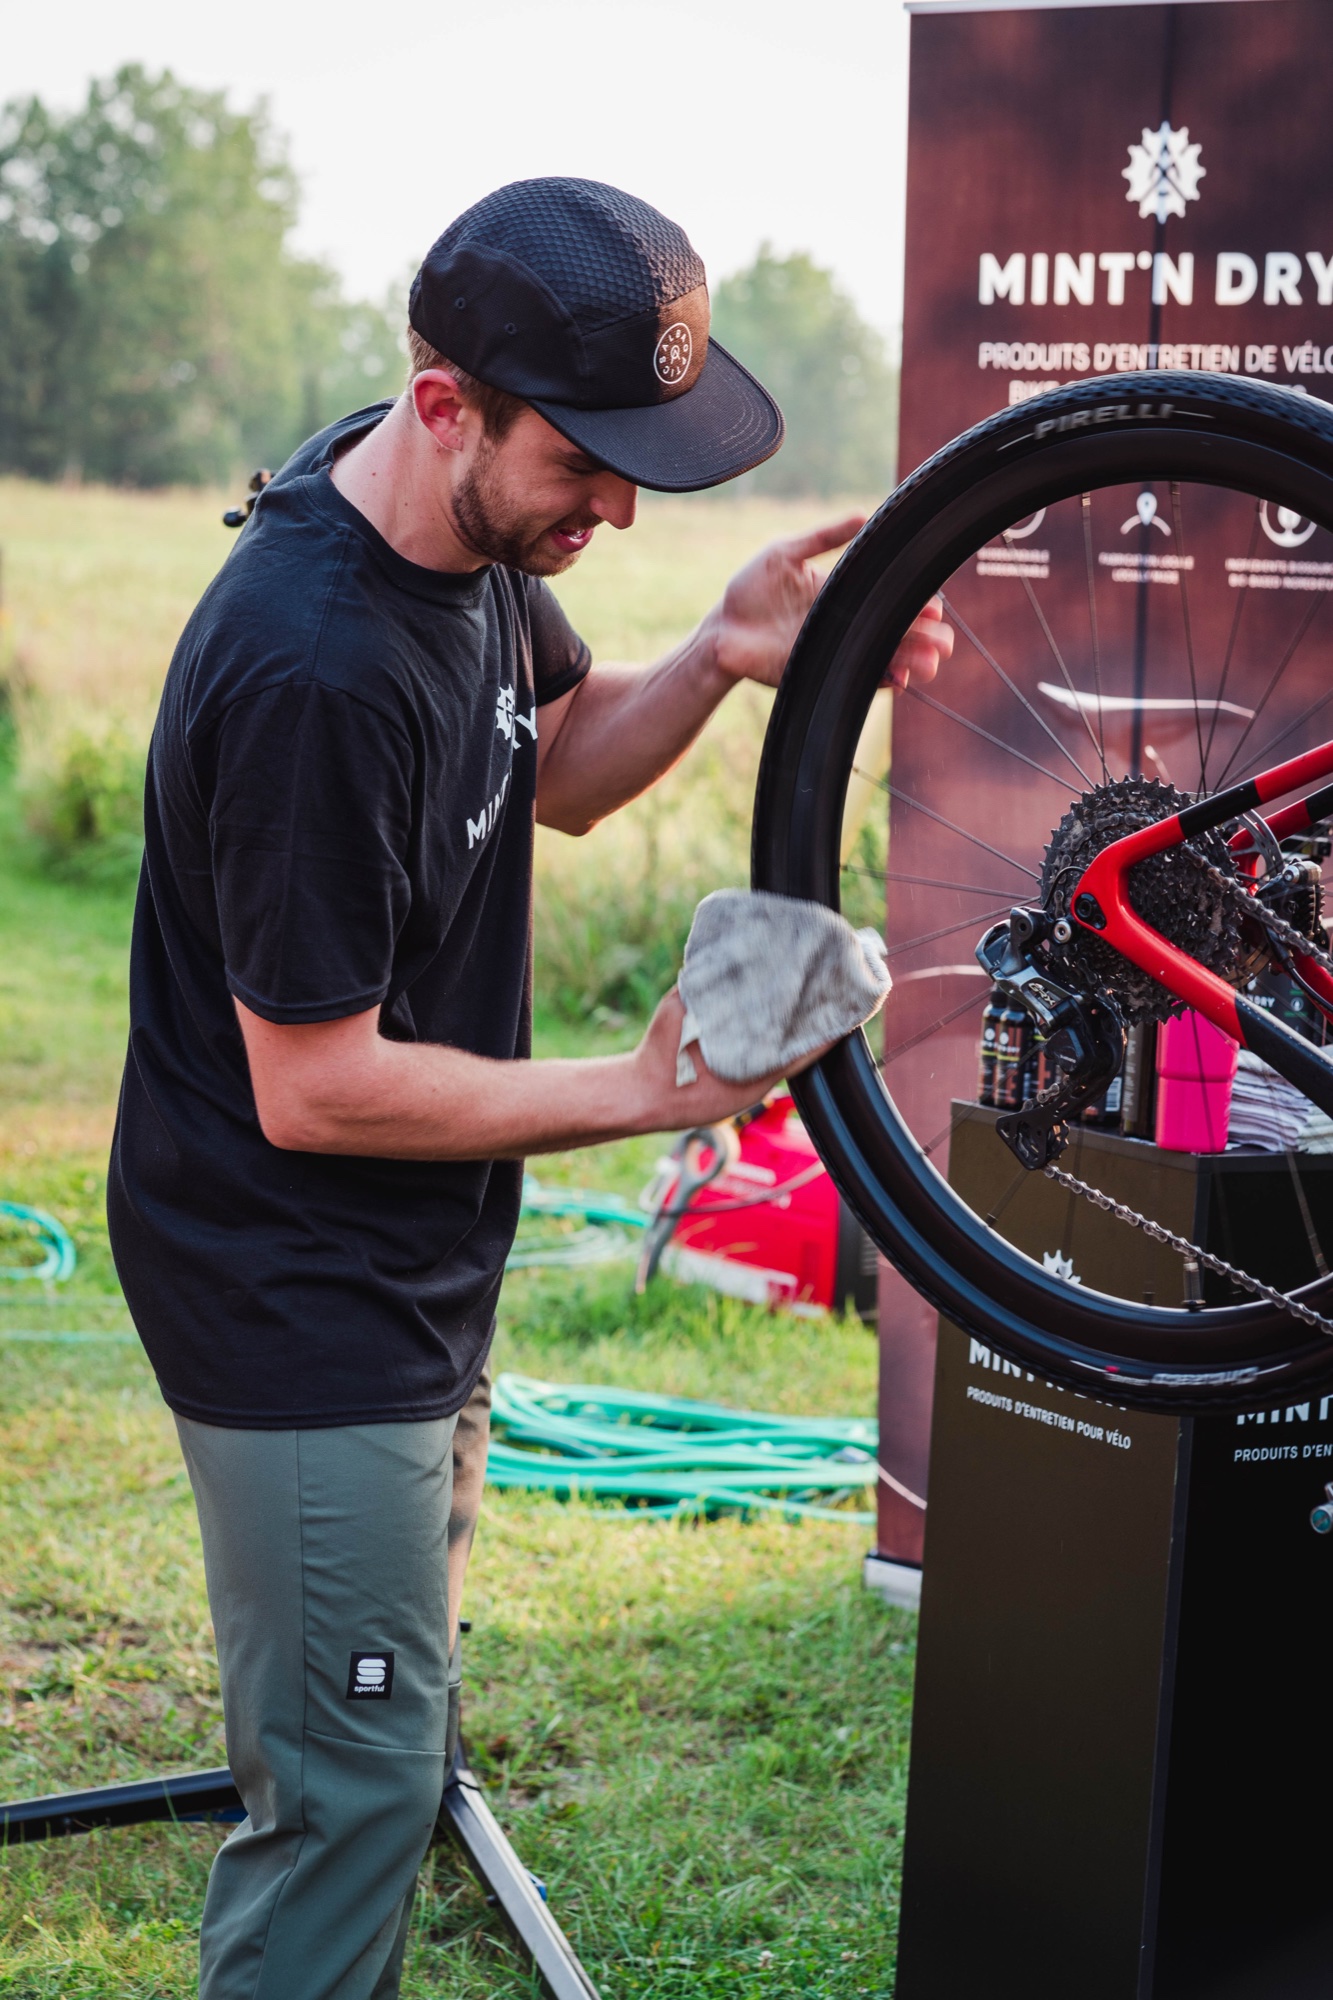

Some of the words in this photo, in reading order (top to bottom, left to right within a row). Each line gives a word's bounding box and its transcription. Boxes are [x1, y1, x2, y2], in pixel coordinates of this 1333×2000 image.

[978, 251, 1194, 305] MINT'N
[1215, 252, 1333, 305] DRY
[978, 342, 1091, 371] PRODUITS
[1093, 343, 1240, 373] D'ENTRETIEN
[1245, 345, 1278, 373] DE
[1033, 403, 1175, 440] PIRELLI
[967, 1386, 1013, 1412] PRODUITS
[1014, 1401, 1075, 1432] D'ENTRETIEN
[1076, 1420, 1104, 1441] POUR
[1105, 1429, 1132, 1450] VÉLO
[1234, 1446, 1298, 1462] PRODUITS
[1302, 1444, 1333, 1458] D'EN
[354, 1685, 385, 1693] sportful
